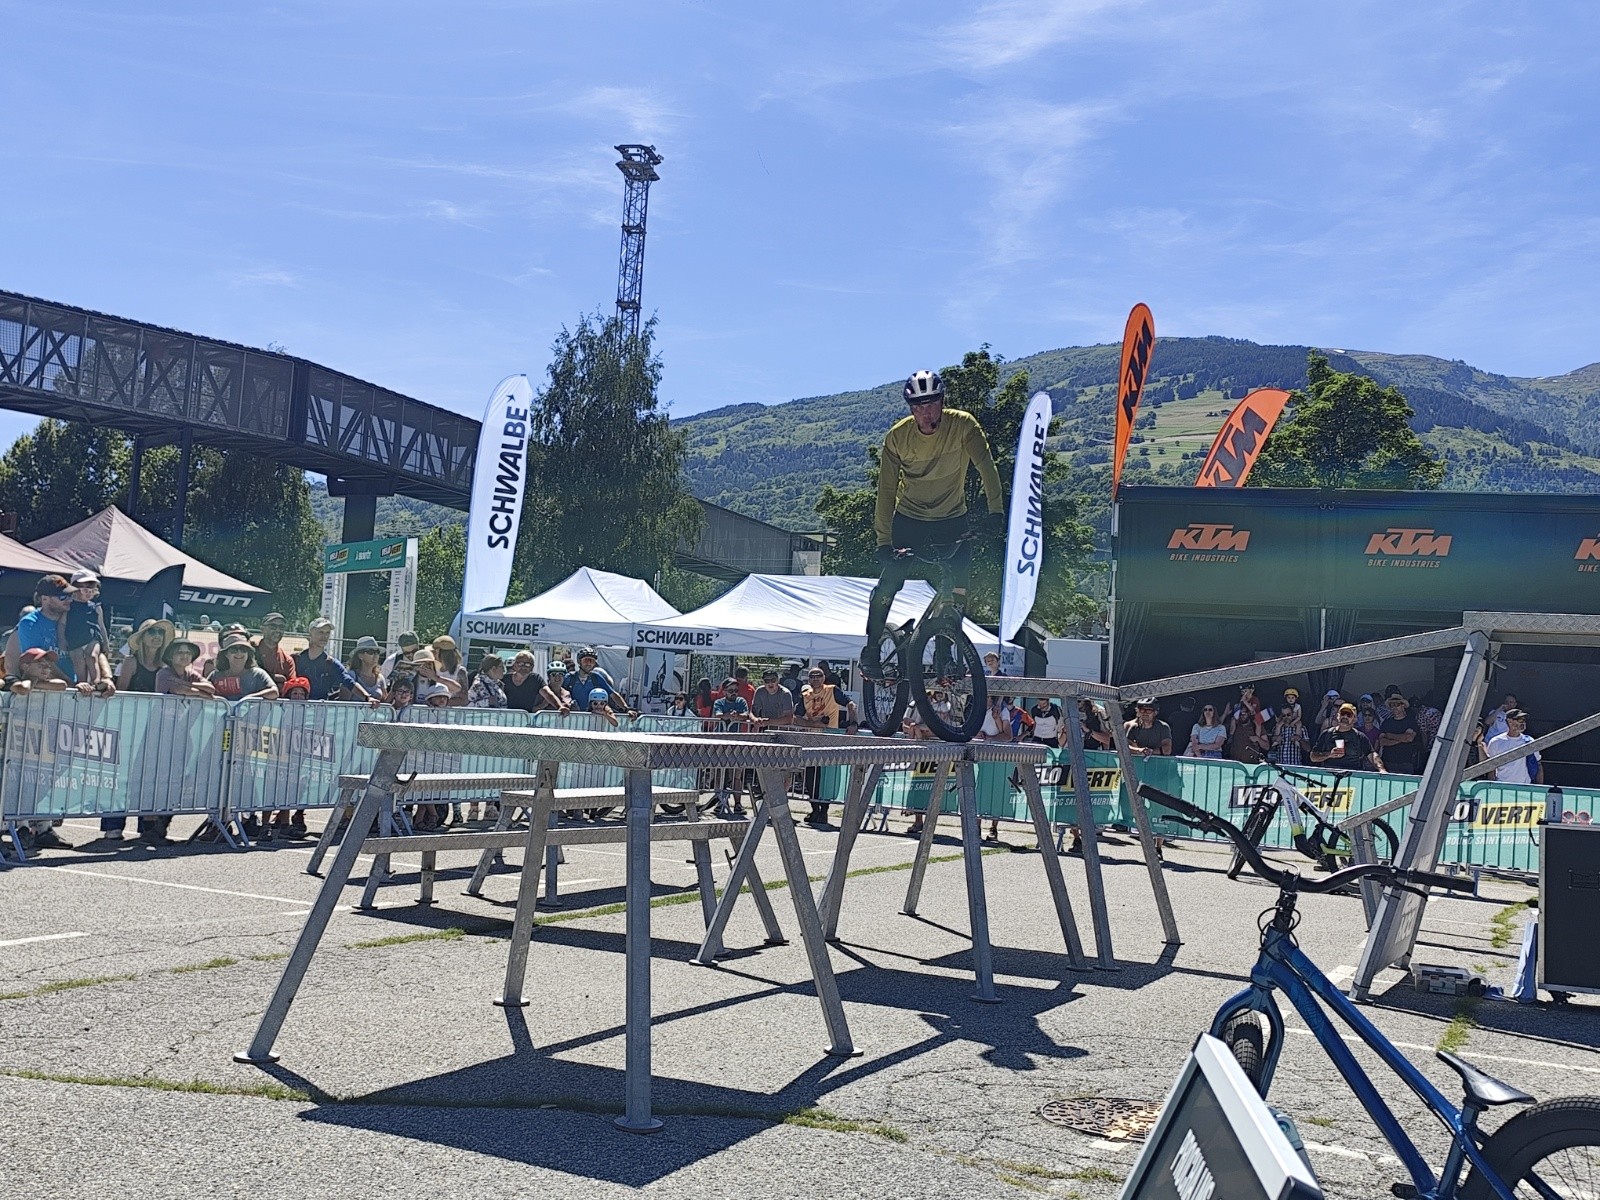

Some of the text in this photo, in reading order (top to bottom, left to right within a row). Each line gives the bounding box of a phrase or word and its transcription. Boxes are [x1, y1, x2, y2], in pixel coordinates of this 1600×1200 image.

[1122, 318, 1153, 427] KTM
[487, 406, 528, 549] SCHWALBE
[1016, 424, 1045, 577] SCHWALBE
[1167, 523, 1251, 552] KTM
[1364, 527, 1453, 557] KTM
[1169, 554, 1239, 563] BIKE INDUSTRIES
[1367, 559, 1440, 568] BIKE INDUSTRIES
[1577, 564, 1599, 573] BIKE
[466, 620, 539, 637] SCHWALBE
[636, 629, 714, 647] SCHWALBE
[1481, 805, 1537, 826] VERT
[1475, 835, 1500, 845] SAINT
